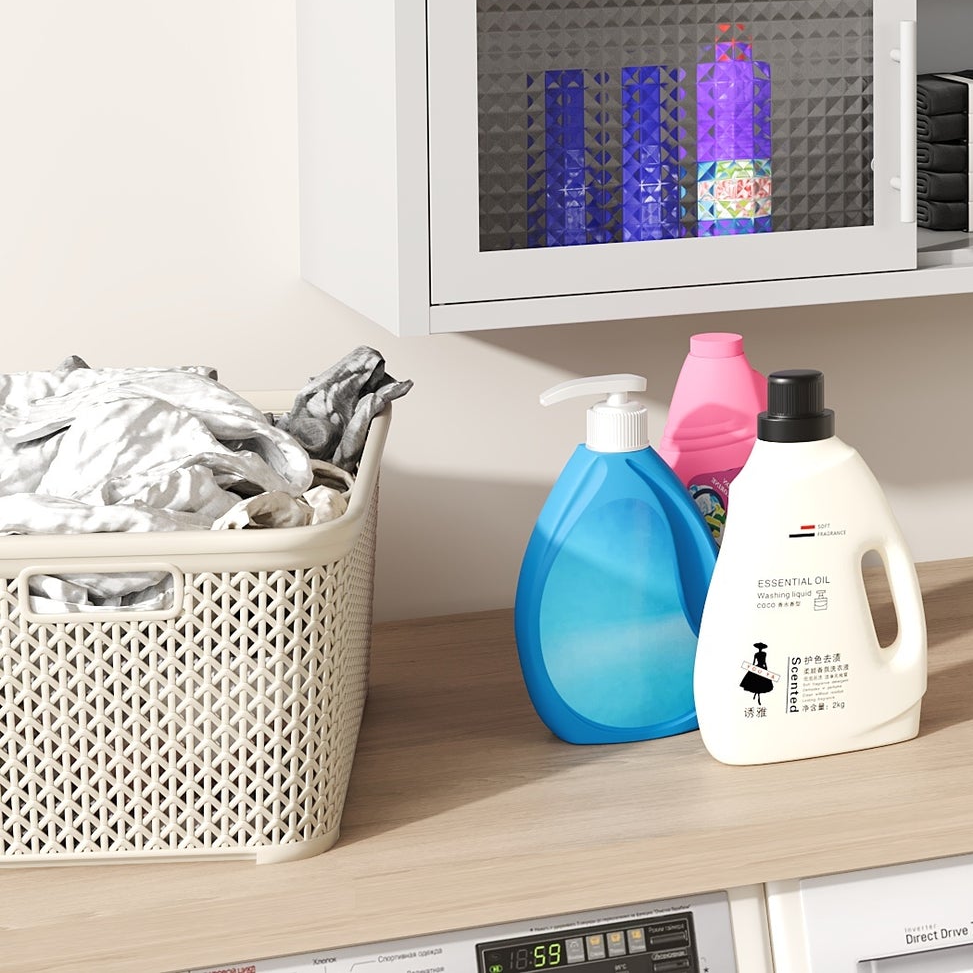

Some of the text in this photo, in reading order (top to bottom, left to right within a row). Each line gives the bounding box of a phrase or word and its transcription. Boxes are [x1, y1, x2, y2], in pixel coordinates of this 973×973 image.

[757, 576, 830, 588] ESSENTIAL OIL
[757, 590, 812, 600] Washing liquid
[789, 657, 801, 714] Scented
[832, 701, 845, 709] 2kg
[906, 931, 938, 944] Direct
[941, 927, 969, 939] Drive
[313, 956, 337, 965] Хлопок
[378, 948, 443, 963] Спортивная одежда
